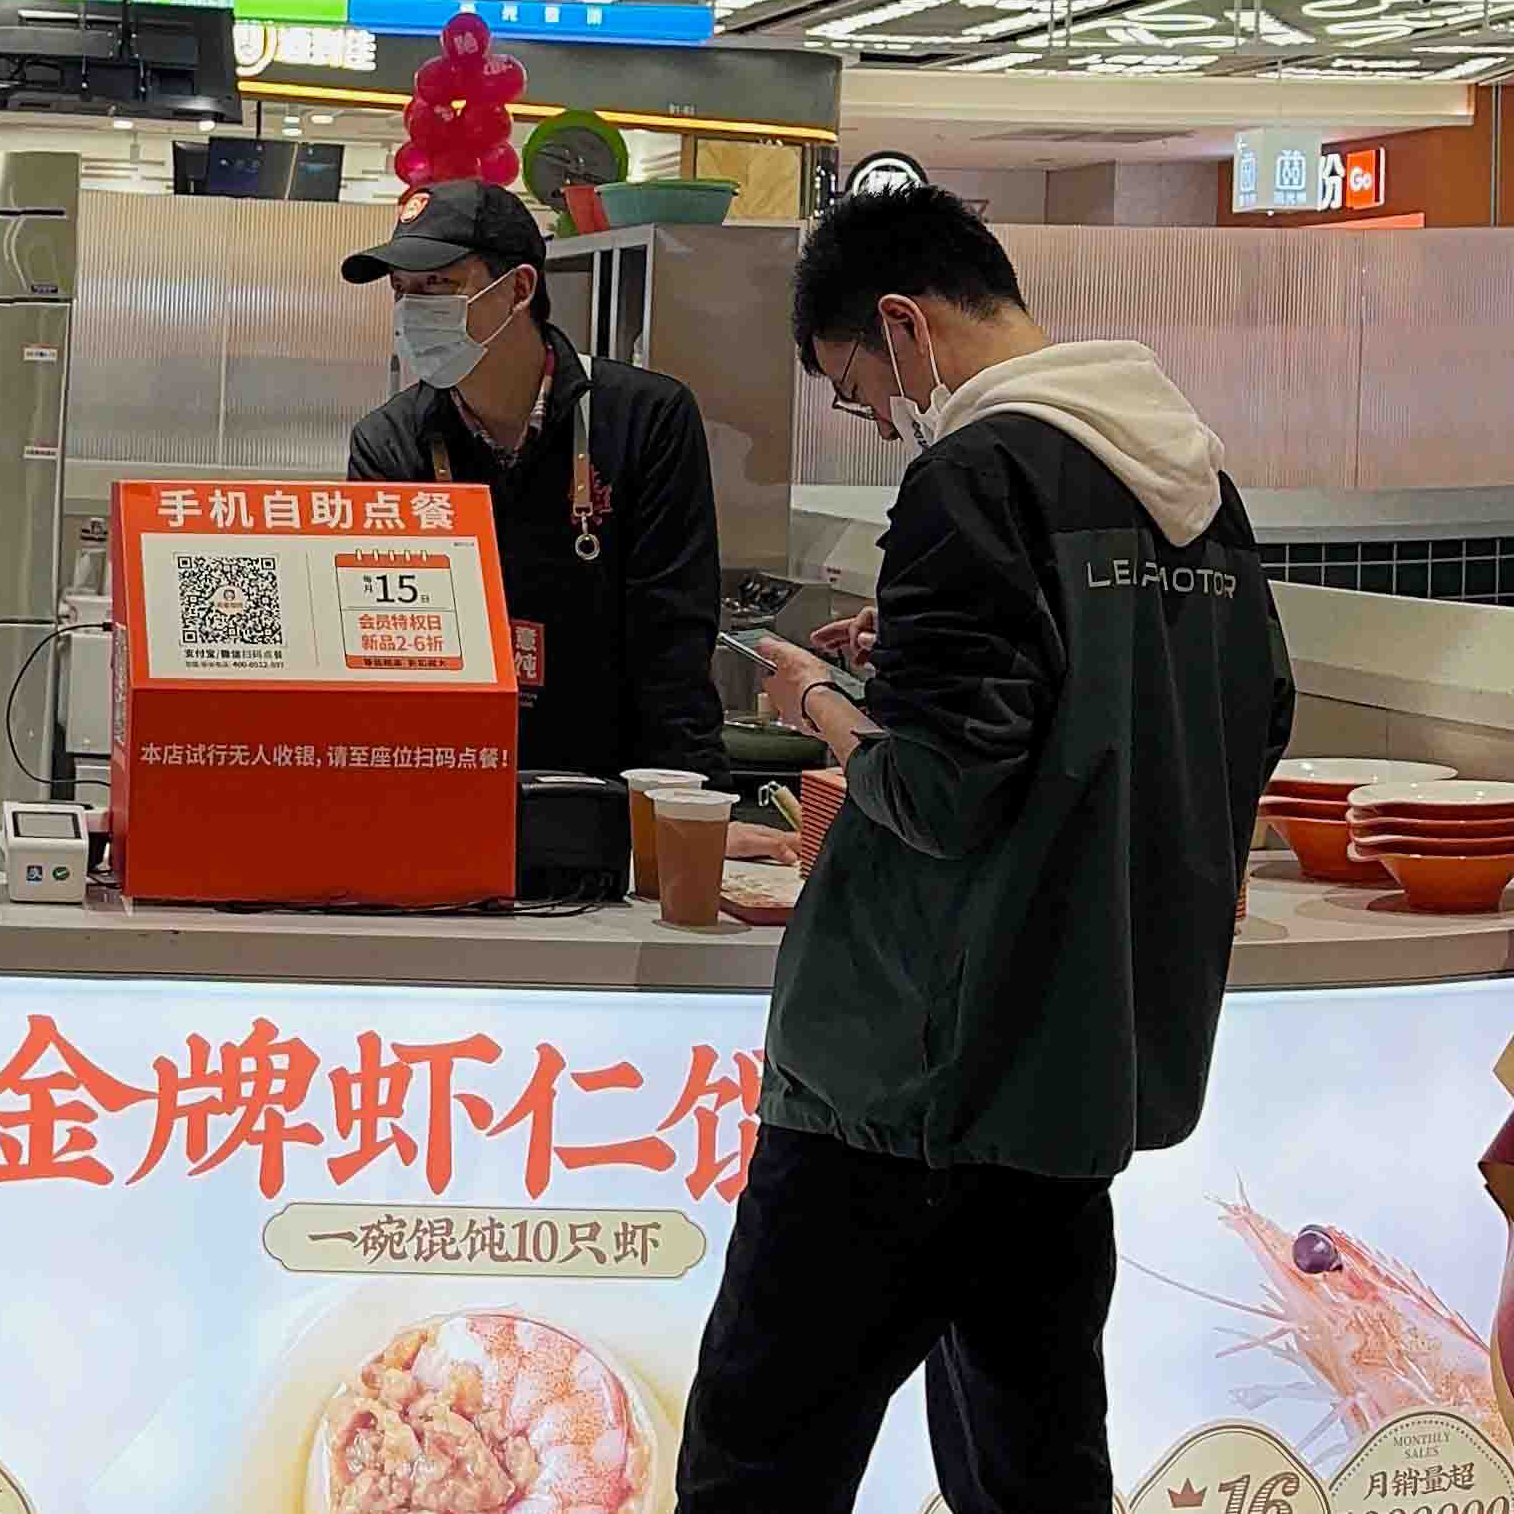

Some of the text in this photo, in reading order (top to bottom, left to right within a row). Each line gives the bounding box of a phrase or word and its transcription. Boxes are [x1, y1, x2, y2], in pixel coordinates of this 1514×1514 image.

[157, 489, 455, 532] 手机自助点餐
[375, 574, 419, 604] 15
[358, 613, 442, 631] 会员特权日
[361, 634, 443, 652] 新品2-6折
[307, 1219, 664, 1271] 一碗馄饨10只虾
[1364, 1462, 1476, 1500] 月销量超
